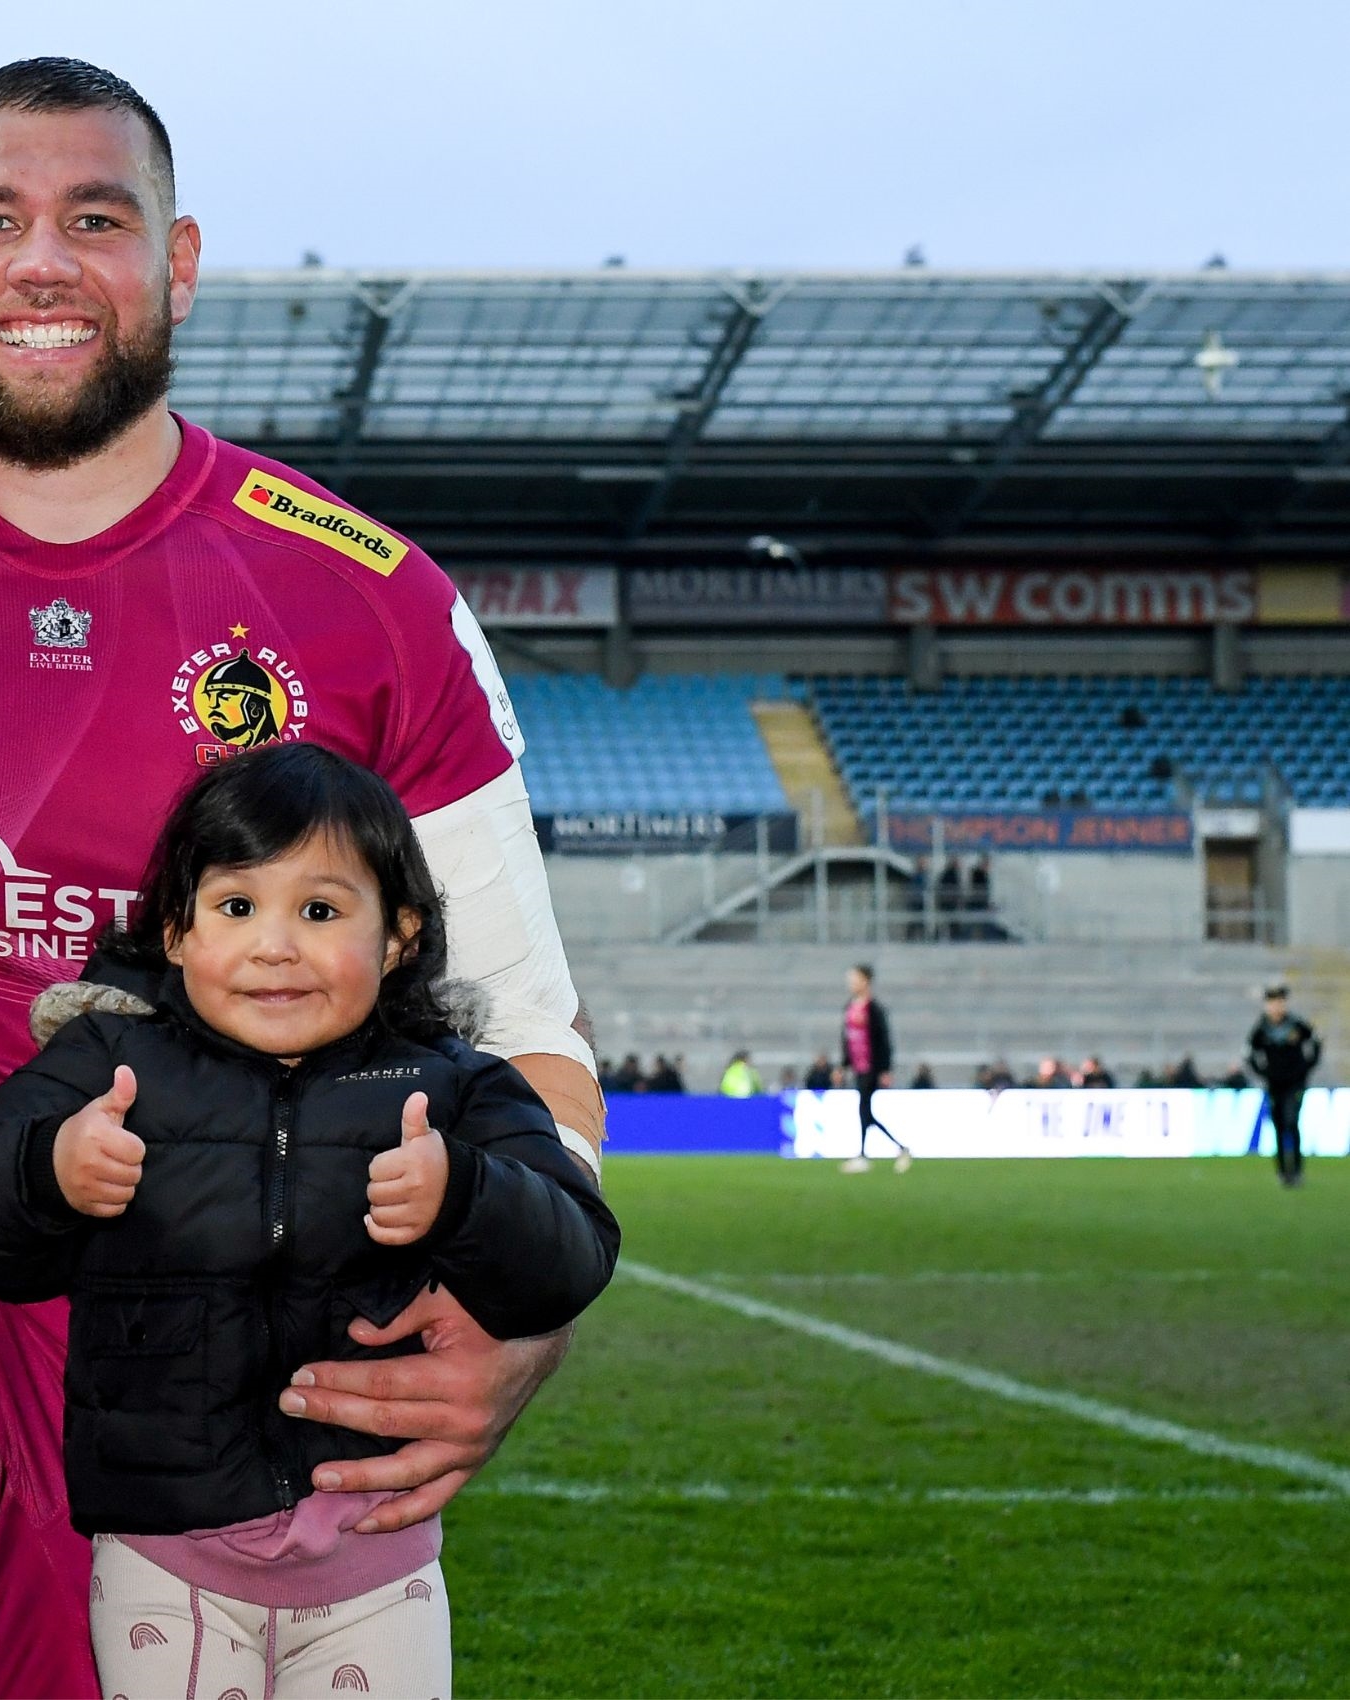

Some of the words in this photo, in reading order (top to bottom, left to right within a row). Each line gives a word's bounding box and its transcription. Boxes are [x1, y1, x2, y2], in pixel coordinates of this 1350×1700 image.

[270, 493, 393, 560] Bradfords
[30, 653, 92, 664] EXETER
[171, 642, 232, 735] EXETER
[257, 646, 308, 739] RUGBY
